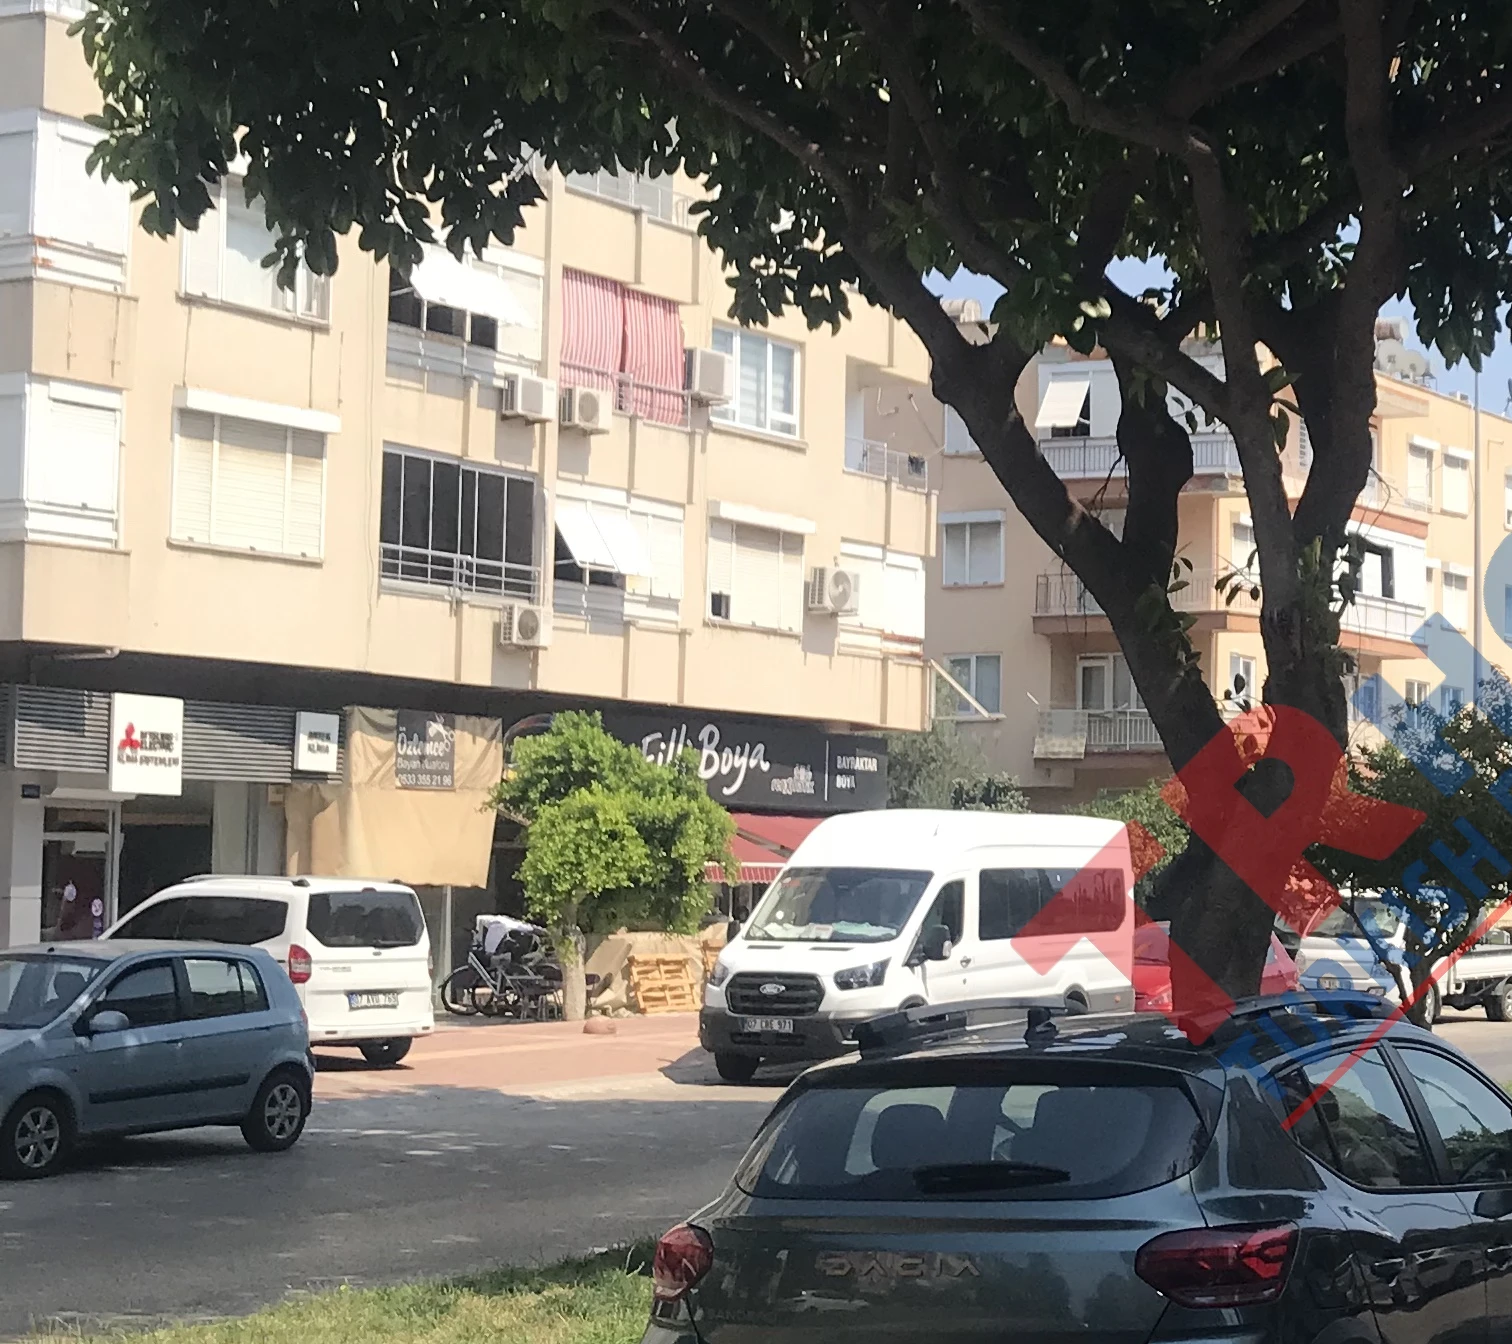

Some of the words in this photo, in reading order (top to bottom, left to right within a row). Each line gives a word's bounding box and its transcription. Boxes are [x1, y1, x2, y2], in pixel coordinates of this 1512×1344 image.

[697, 723, 771, 796] Boya
[836, 755, 878, 772] BAYRAKTAR
[835, 774, 856, 789] BOYA
